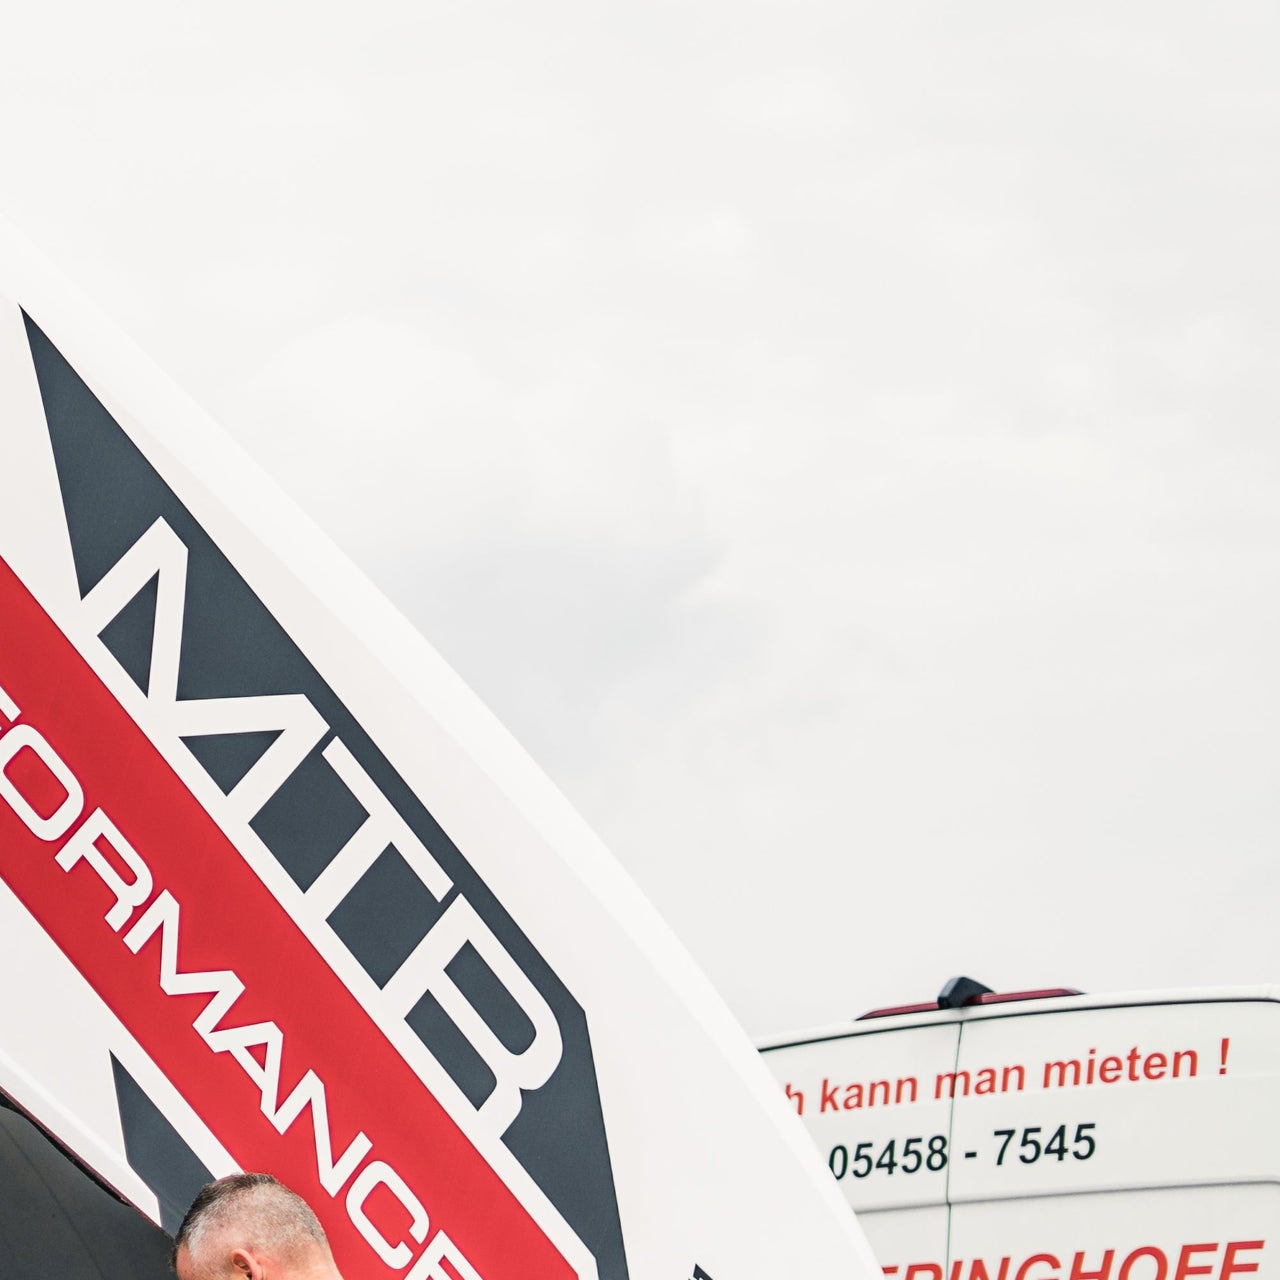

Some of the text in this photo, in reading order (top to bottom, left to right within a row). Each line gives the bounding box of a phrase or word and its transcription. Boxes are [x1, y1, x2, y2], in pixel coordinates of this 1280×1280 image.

[820, 1077, 918, 1113] kann
[935, 1065, 1025, 1100] man
[1043, 1047, 1198, 1089] mieten
[828, 1135, 948, 1181] 05458
[993, 1123, 1096, 1166] 7545
